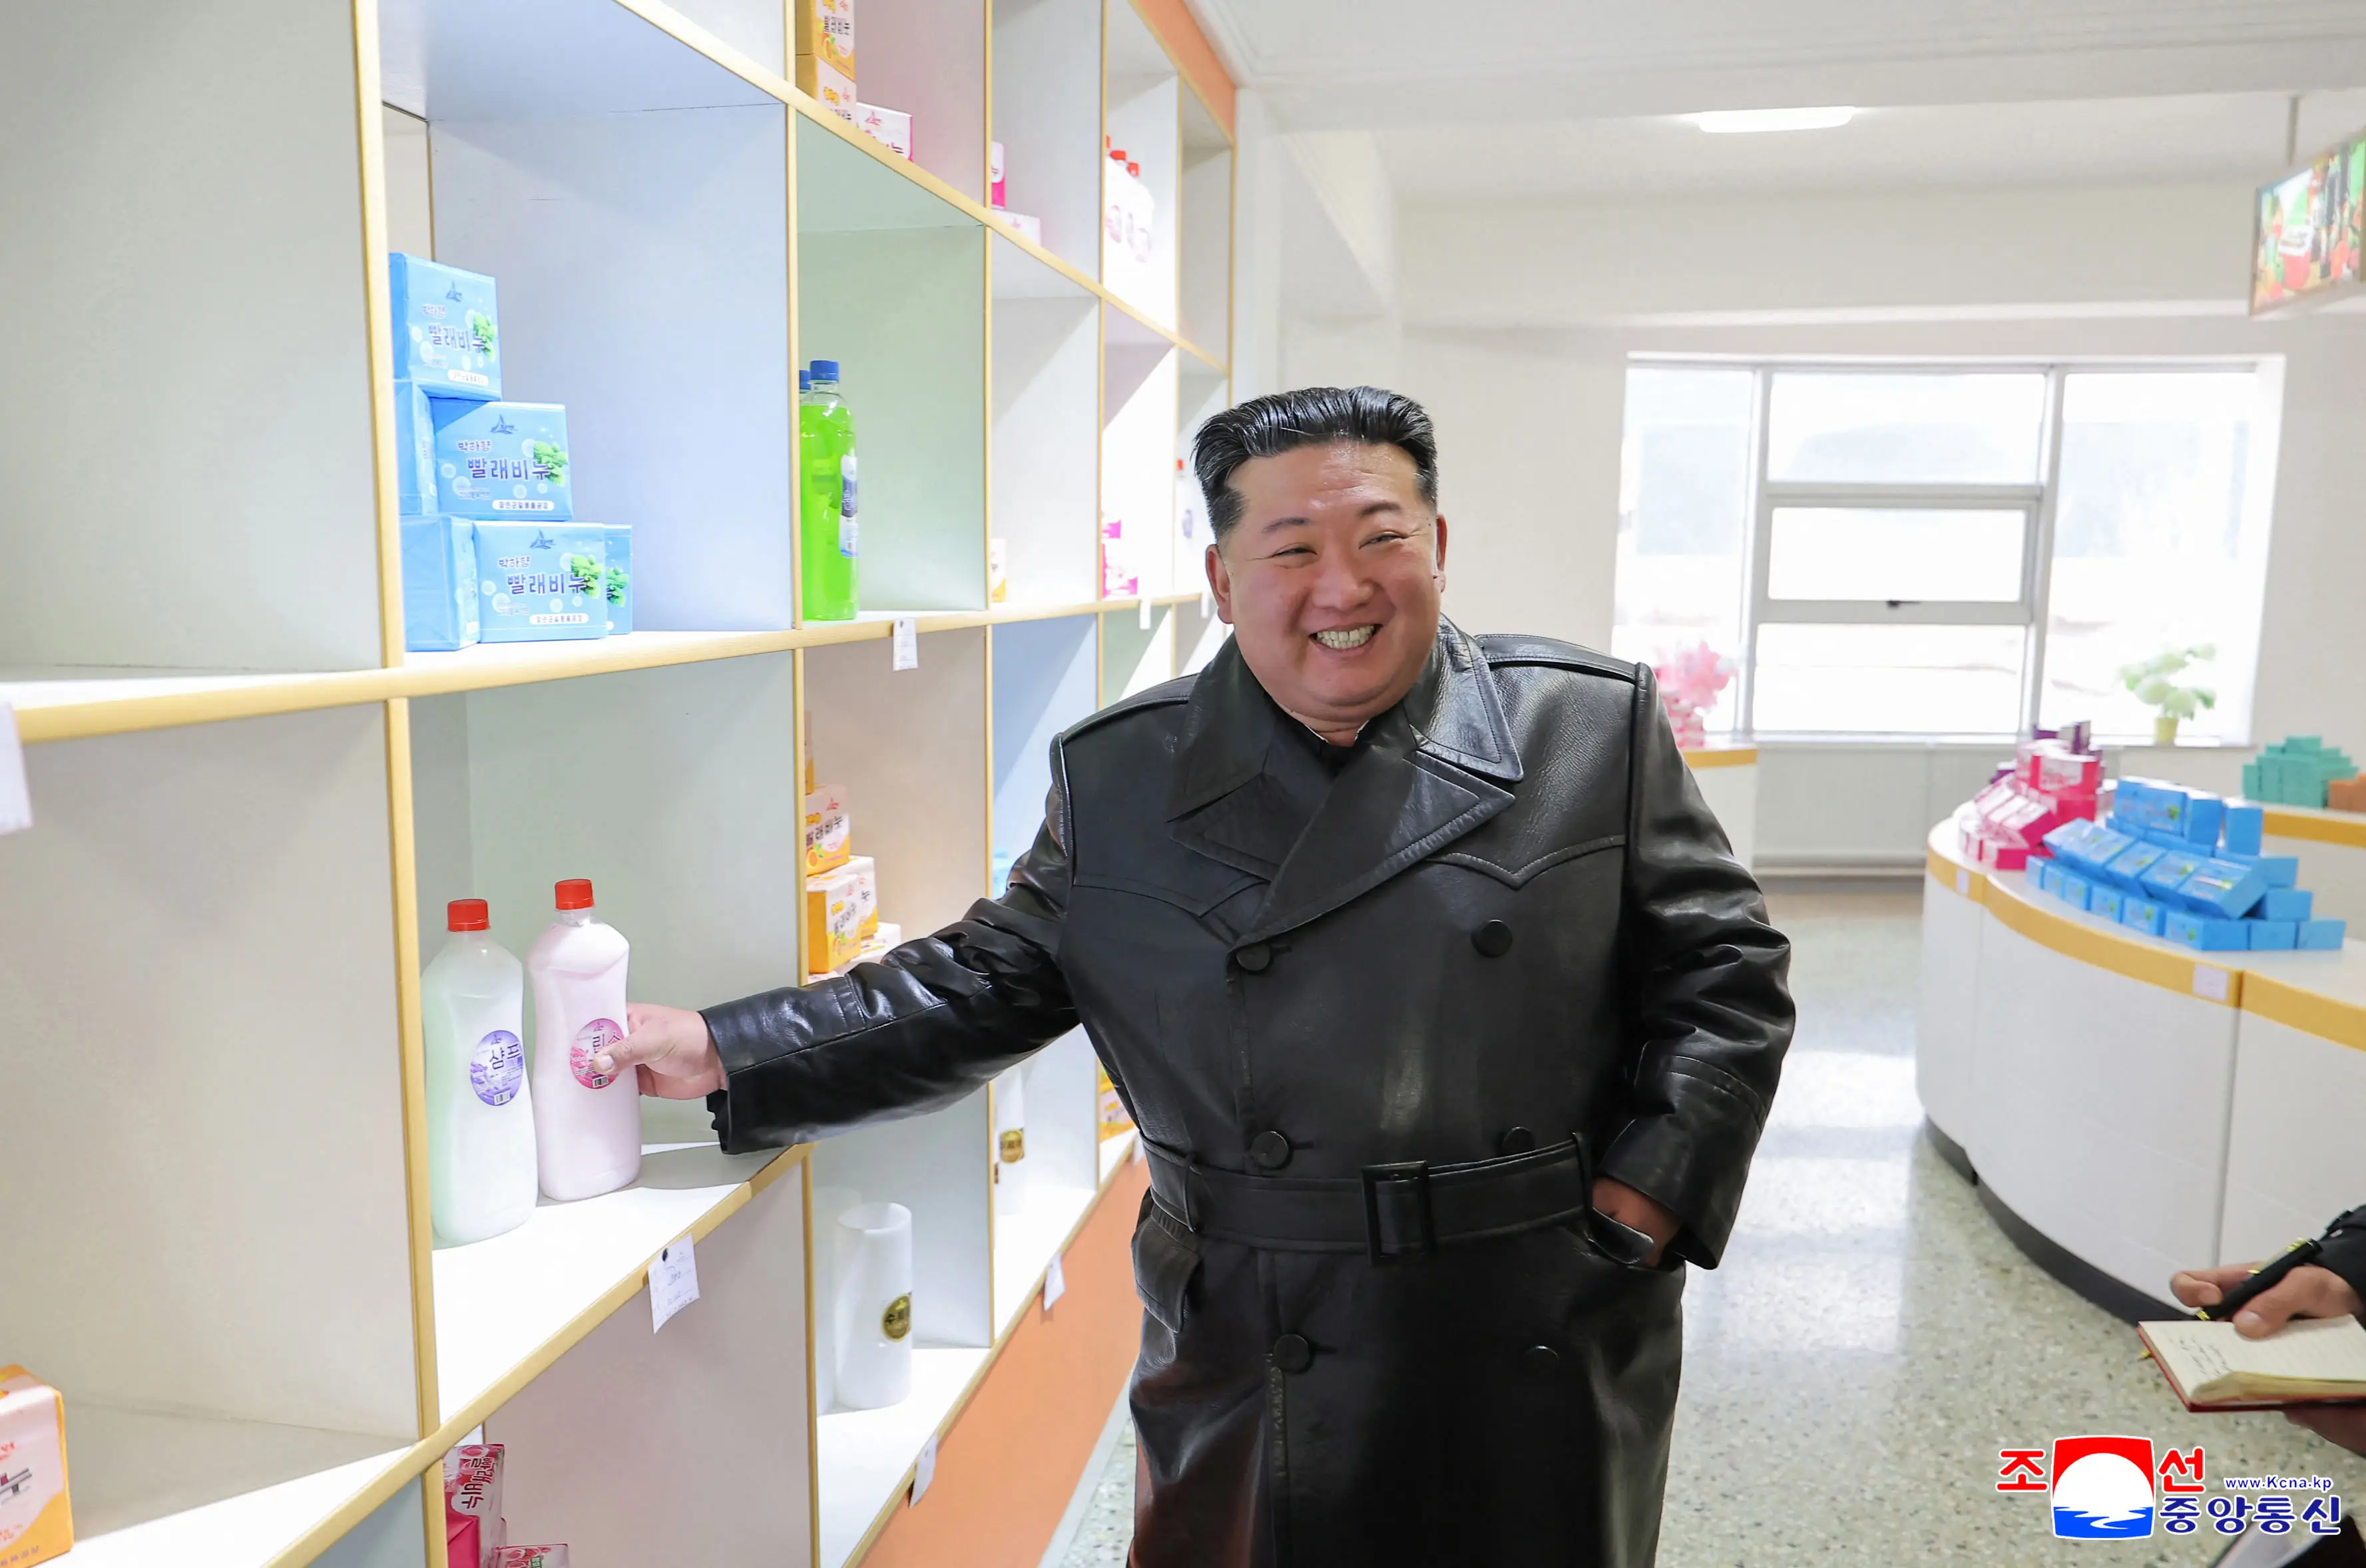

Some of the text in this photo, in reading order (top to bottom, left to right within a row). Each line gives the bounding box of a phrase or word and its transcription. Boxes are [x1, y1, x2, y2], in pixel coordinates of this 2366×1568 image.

[428, 323, 485, 353] 빨래비누
[458, 440, 491, 451] 박하향
[467, 457, 551, 481] 빨래비누
[499, 556, 530, 568] 박하향
[507, 573, 587, 595] 빨래비누
[489, 1043, 521, 1070] 샴푸
[461, 1456, 493, 1509] 빨래비누
